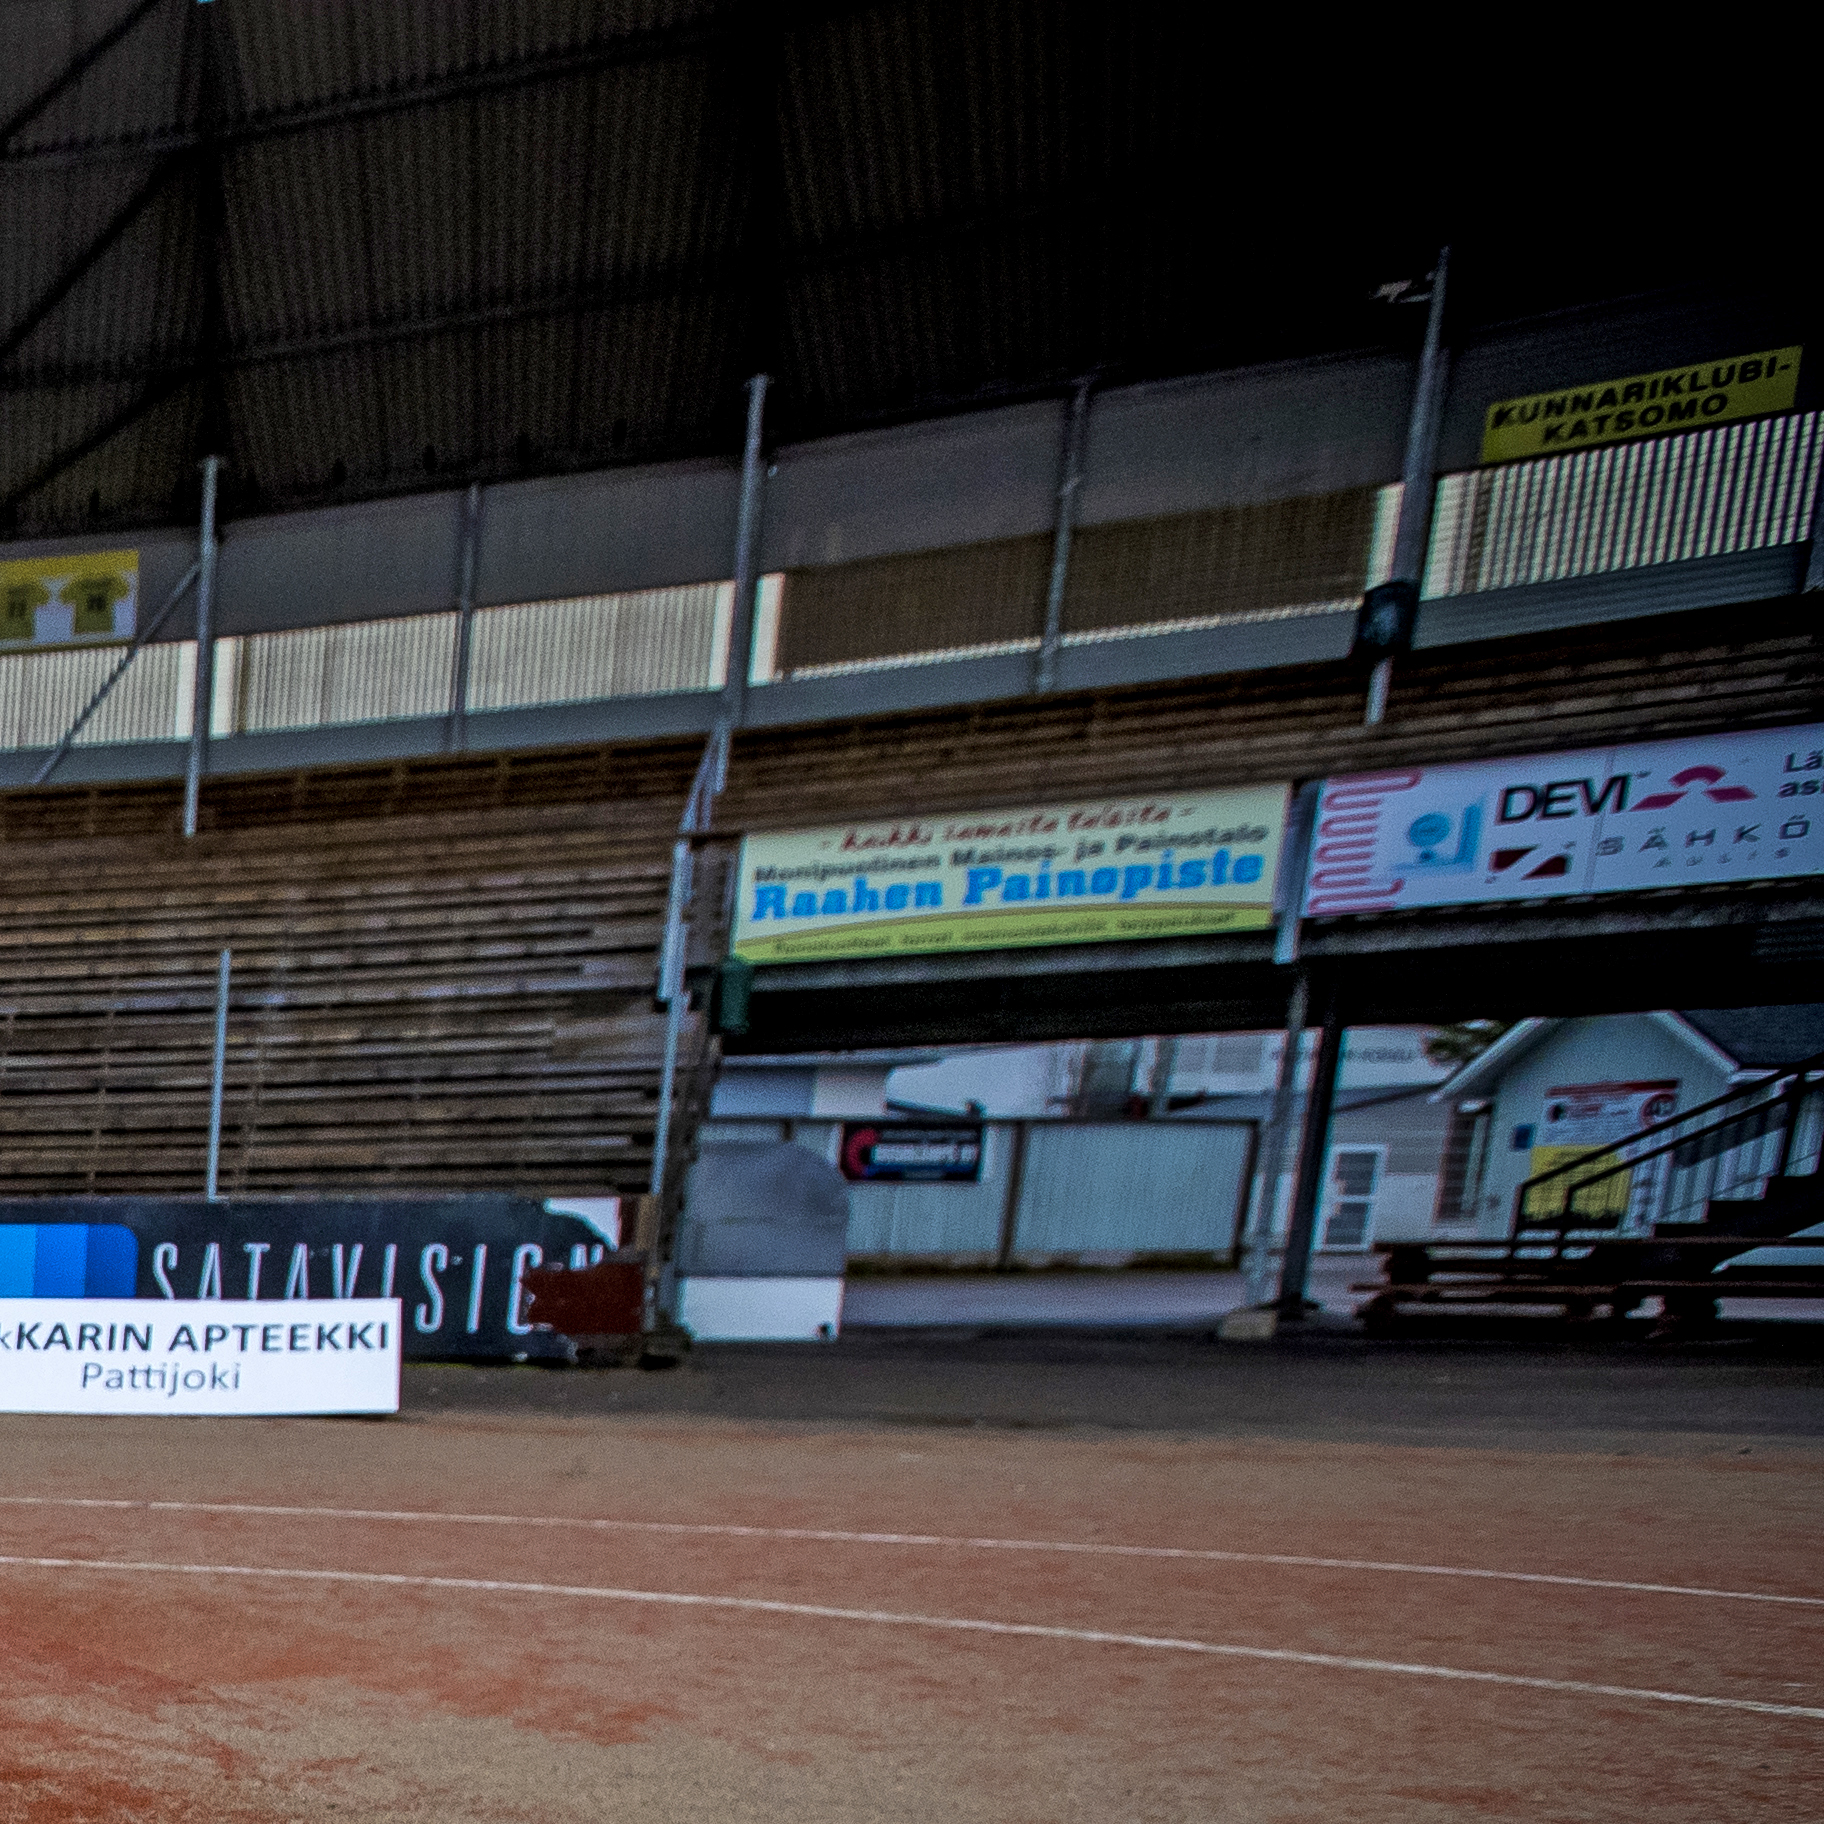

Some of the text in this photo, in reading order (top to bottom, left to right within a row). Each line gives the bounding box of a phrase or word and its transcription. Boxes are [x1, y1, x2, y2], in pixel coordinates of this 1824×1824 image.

[1491, 355, 1791, 430] KUNNARIKLUBI-
[1541, 393, 1729, 445] KATSOMO
[1495, 772, 1632, 827] DEVI
[1777, 777, 1824, 798] as
[1073, 837, 1106, 864] ja
[751, 847, 1265, 922] Raahen Painopiste
[152, 1241, 603, 1335] SATAVISIO
[168, 1321, 390, 1352] APTEEKKI
[80, 1361, 242, 1397] Pattijoki
